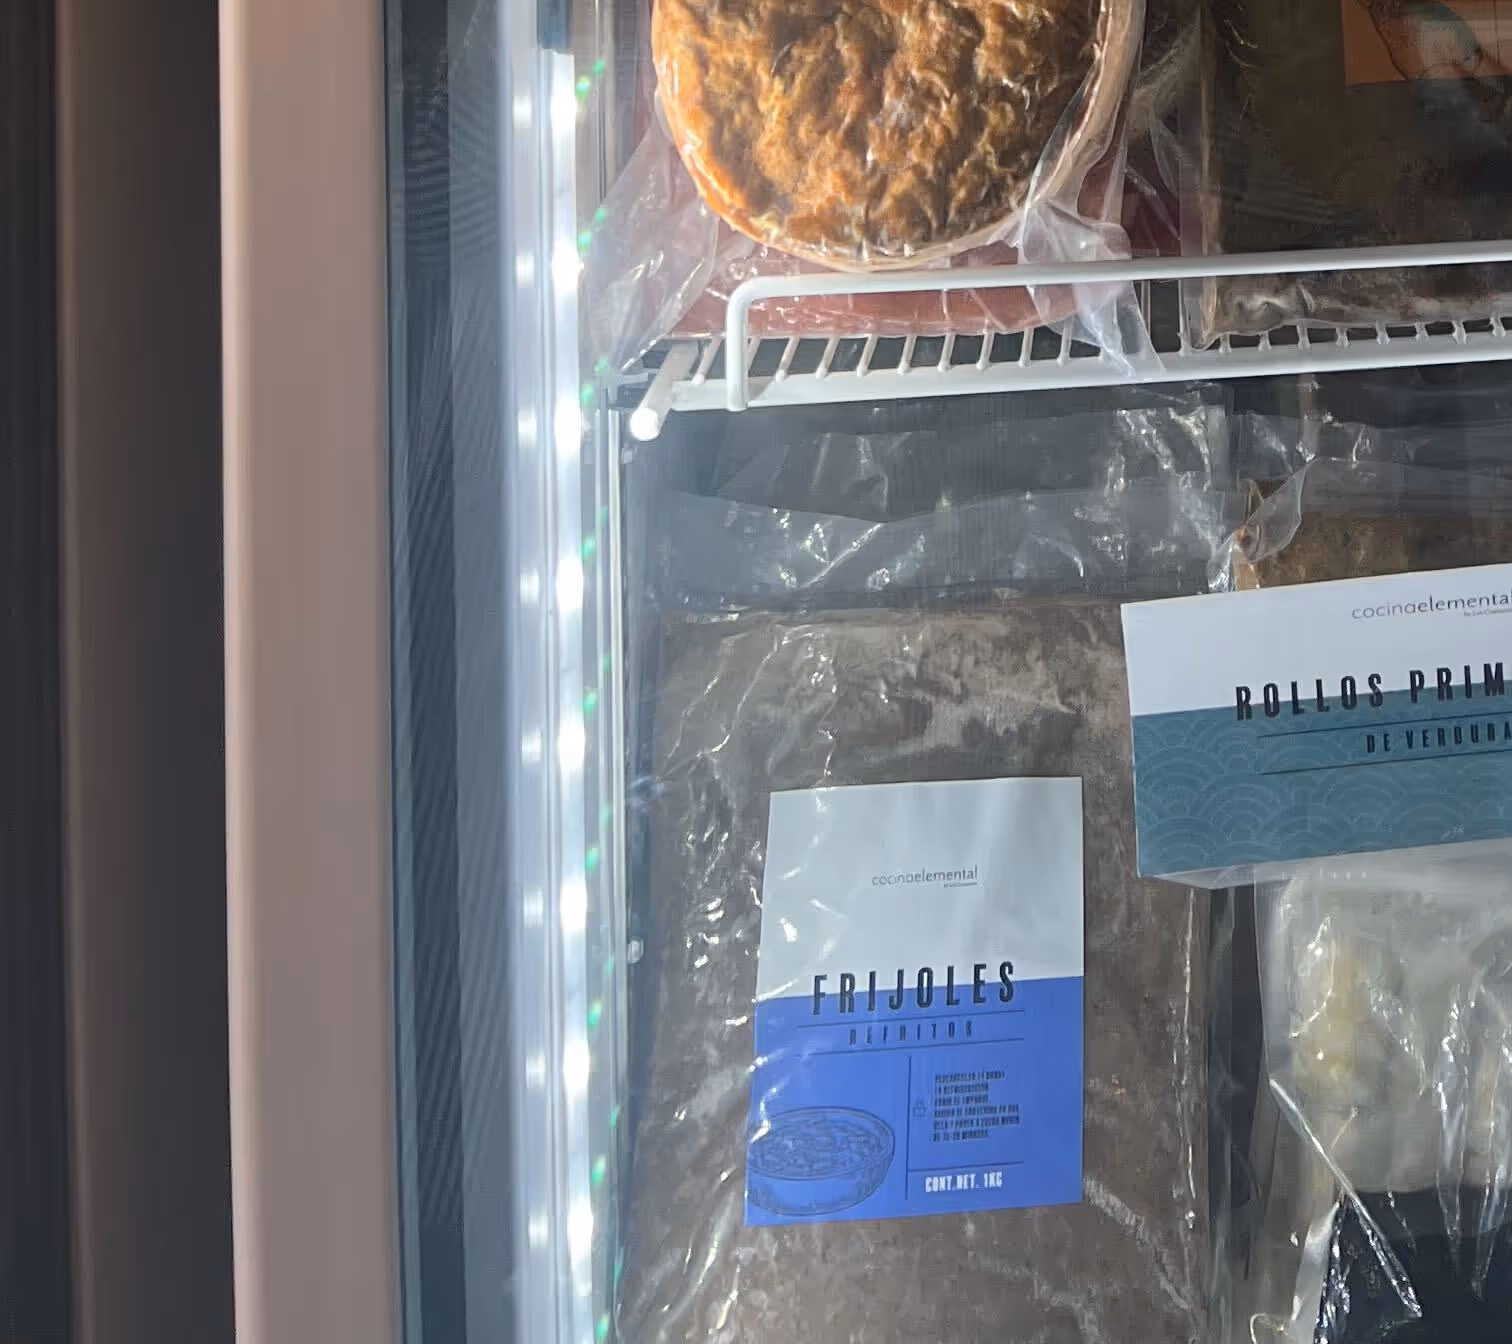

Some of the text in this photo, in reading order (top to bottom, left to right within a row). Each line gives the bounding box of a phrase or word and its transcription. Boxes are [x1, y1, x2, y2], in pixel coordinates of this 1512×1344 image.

[1236, 672, 1384, 720] ROLLOS
[1366, 720, 1512, 753] DE VERDURA
[813, 961, 1014, 1015] FRIJOLES
